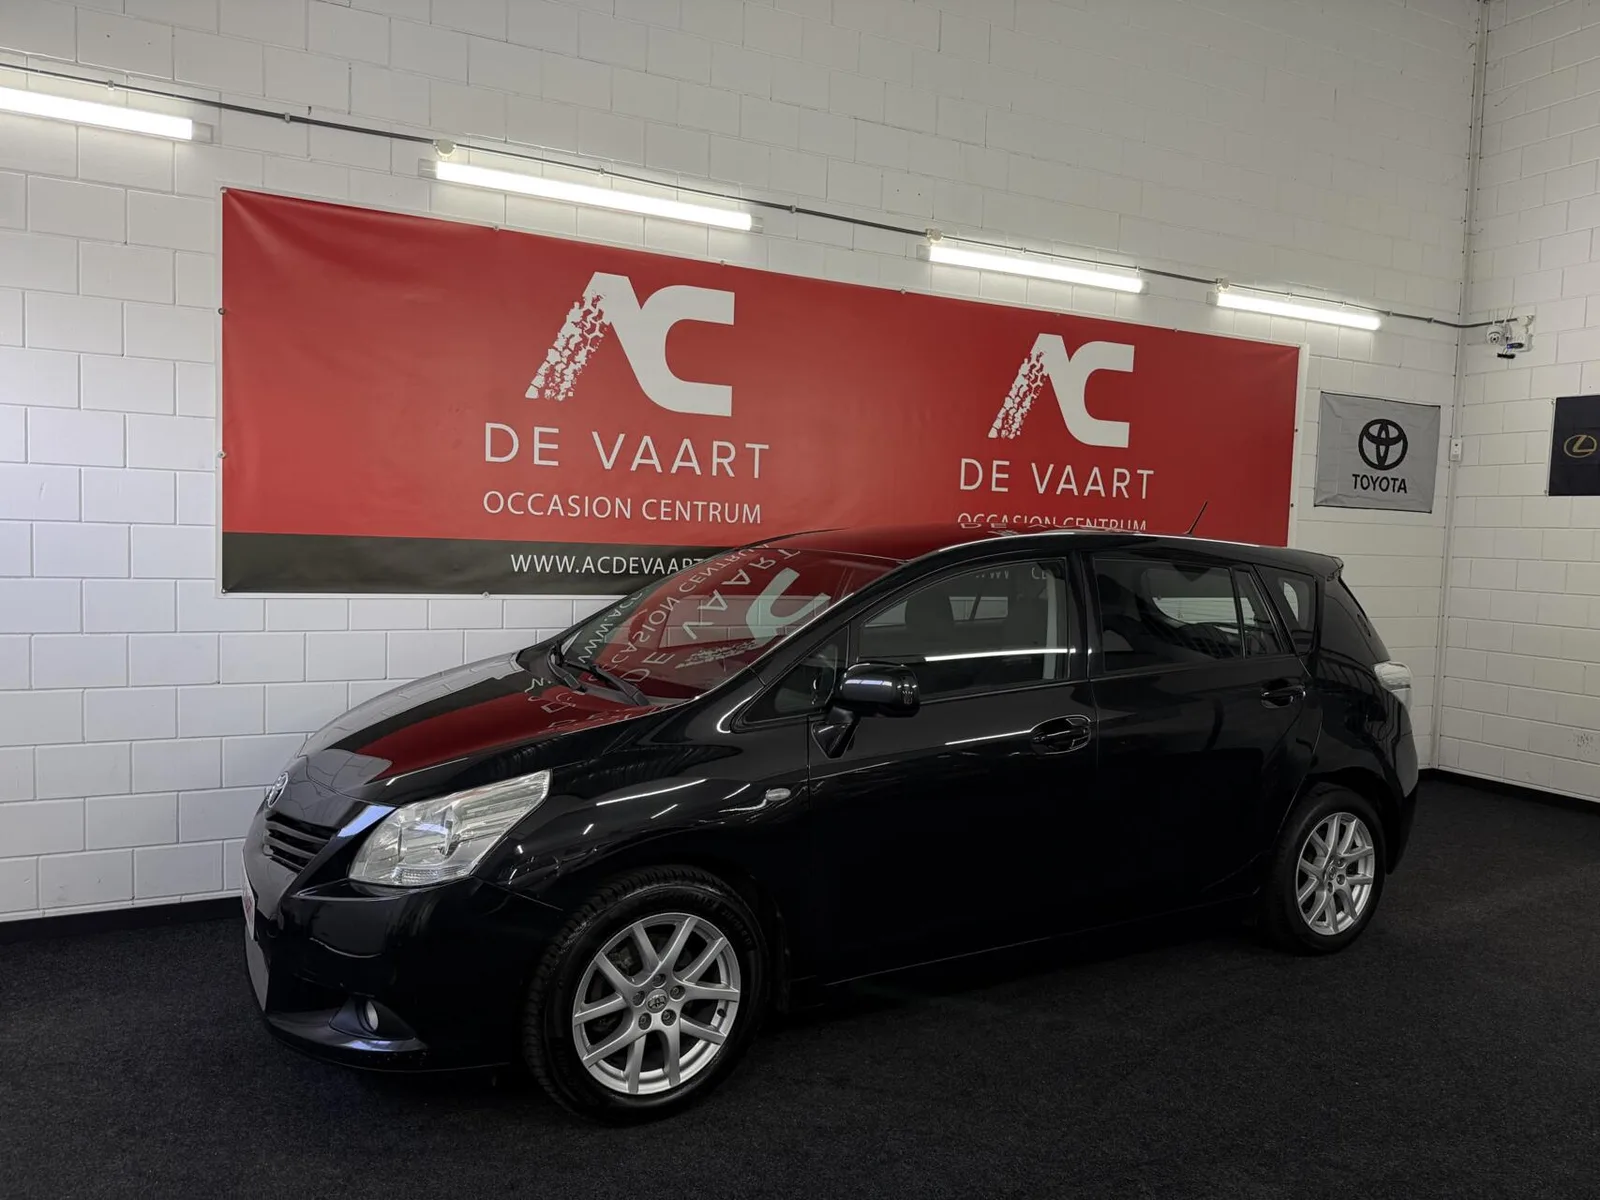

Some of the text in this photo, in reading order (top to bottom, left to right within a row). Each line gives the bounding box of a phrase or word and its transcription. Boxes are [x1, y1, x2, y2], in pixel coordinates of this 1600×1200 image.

[485, 422, 770, 479] DE VAART
[959, 457, 1155, 500] DE VAART
[1351, 473, 1408, 494] TOYOTA
[483, 490, 762, 524] OCCASION CENTRUM
